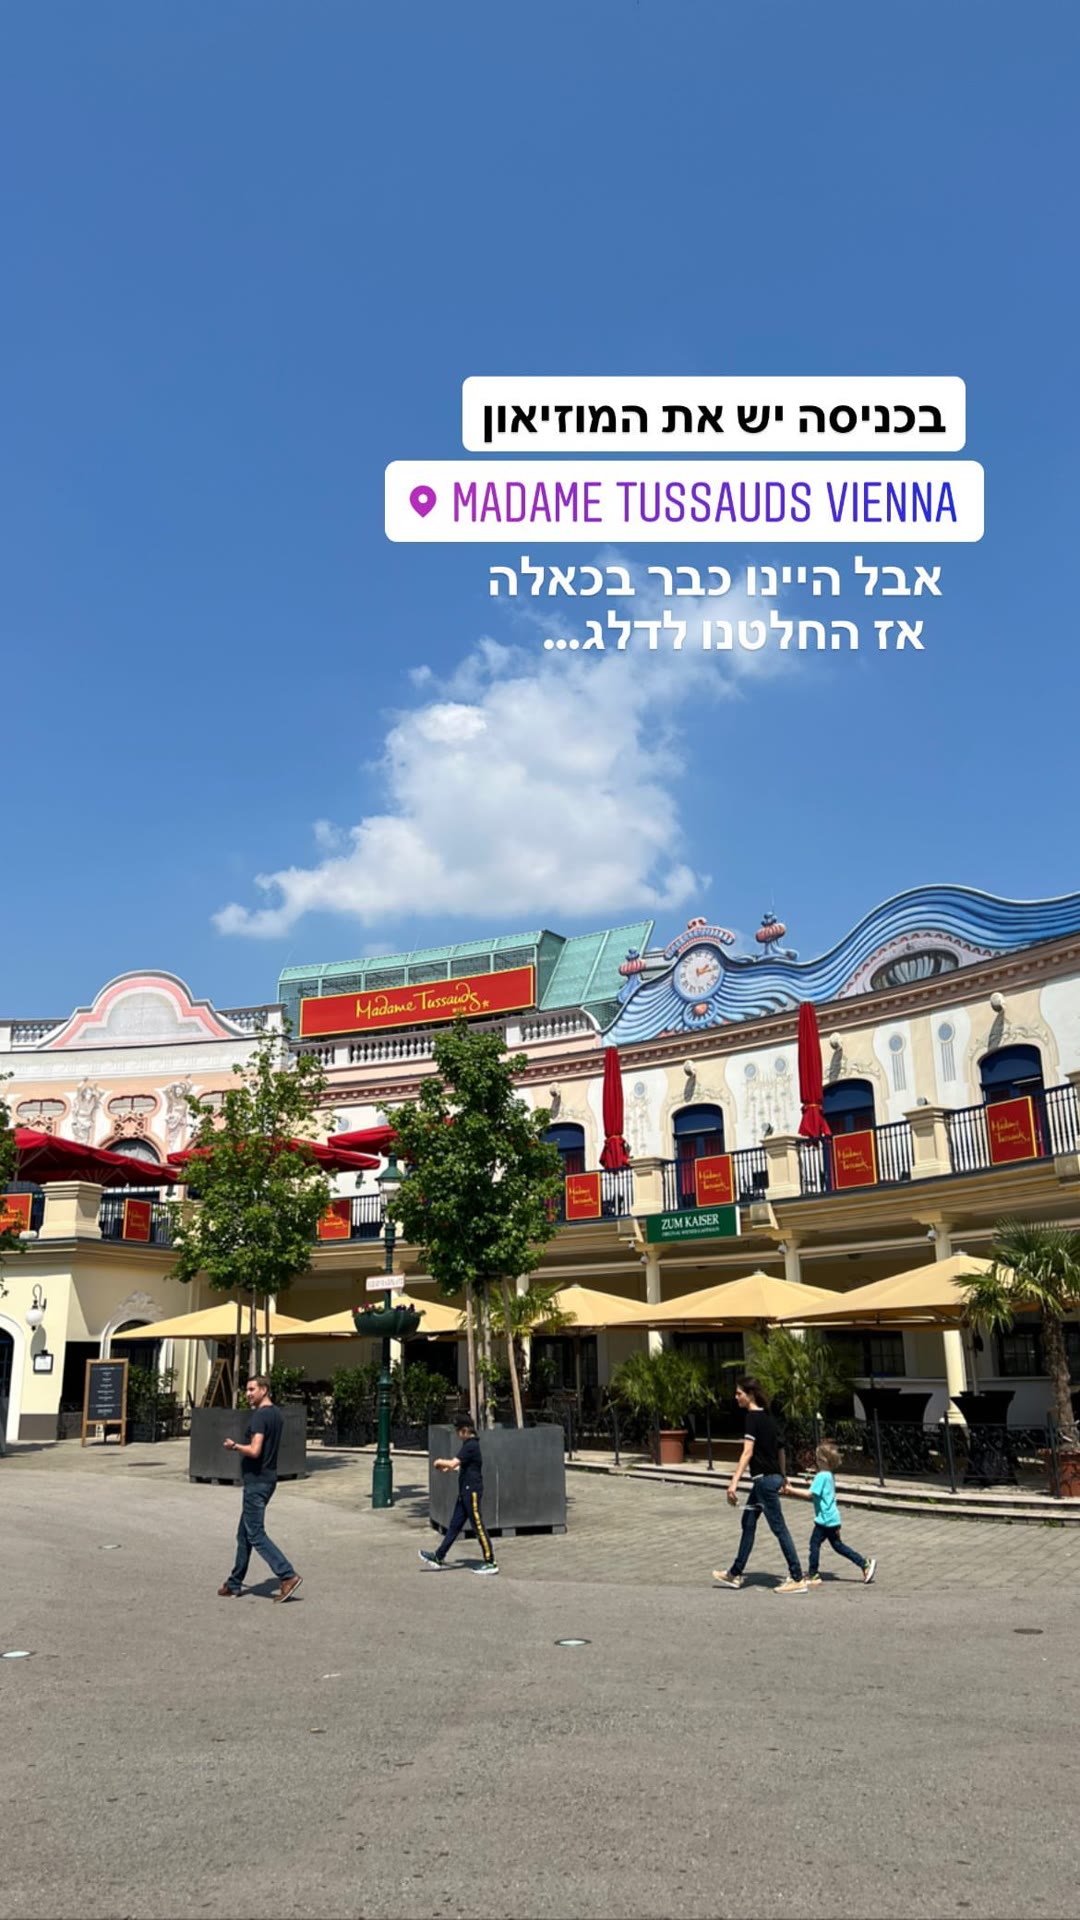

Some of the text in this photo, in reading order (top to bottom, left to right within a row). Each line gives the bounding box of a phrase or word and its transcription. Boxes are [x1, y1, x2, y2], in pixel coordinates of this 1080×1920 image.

[356, 982, 480, 1019] Madame Tussauds
[661, 1213, 720, 1230] ZUM KAISER
